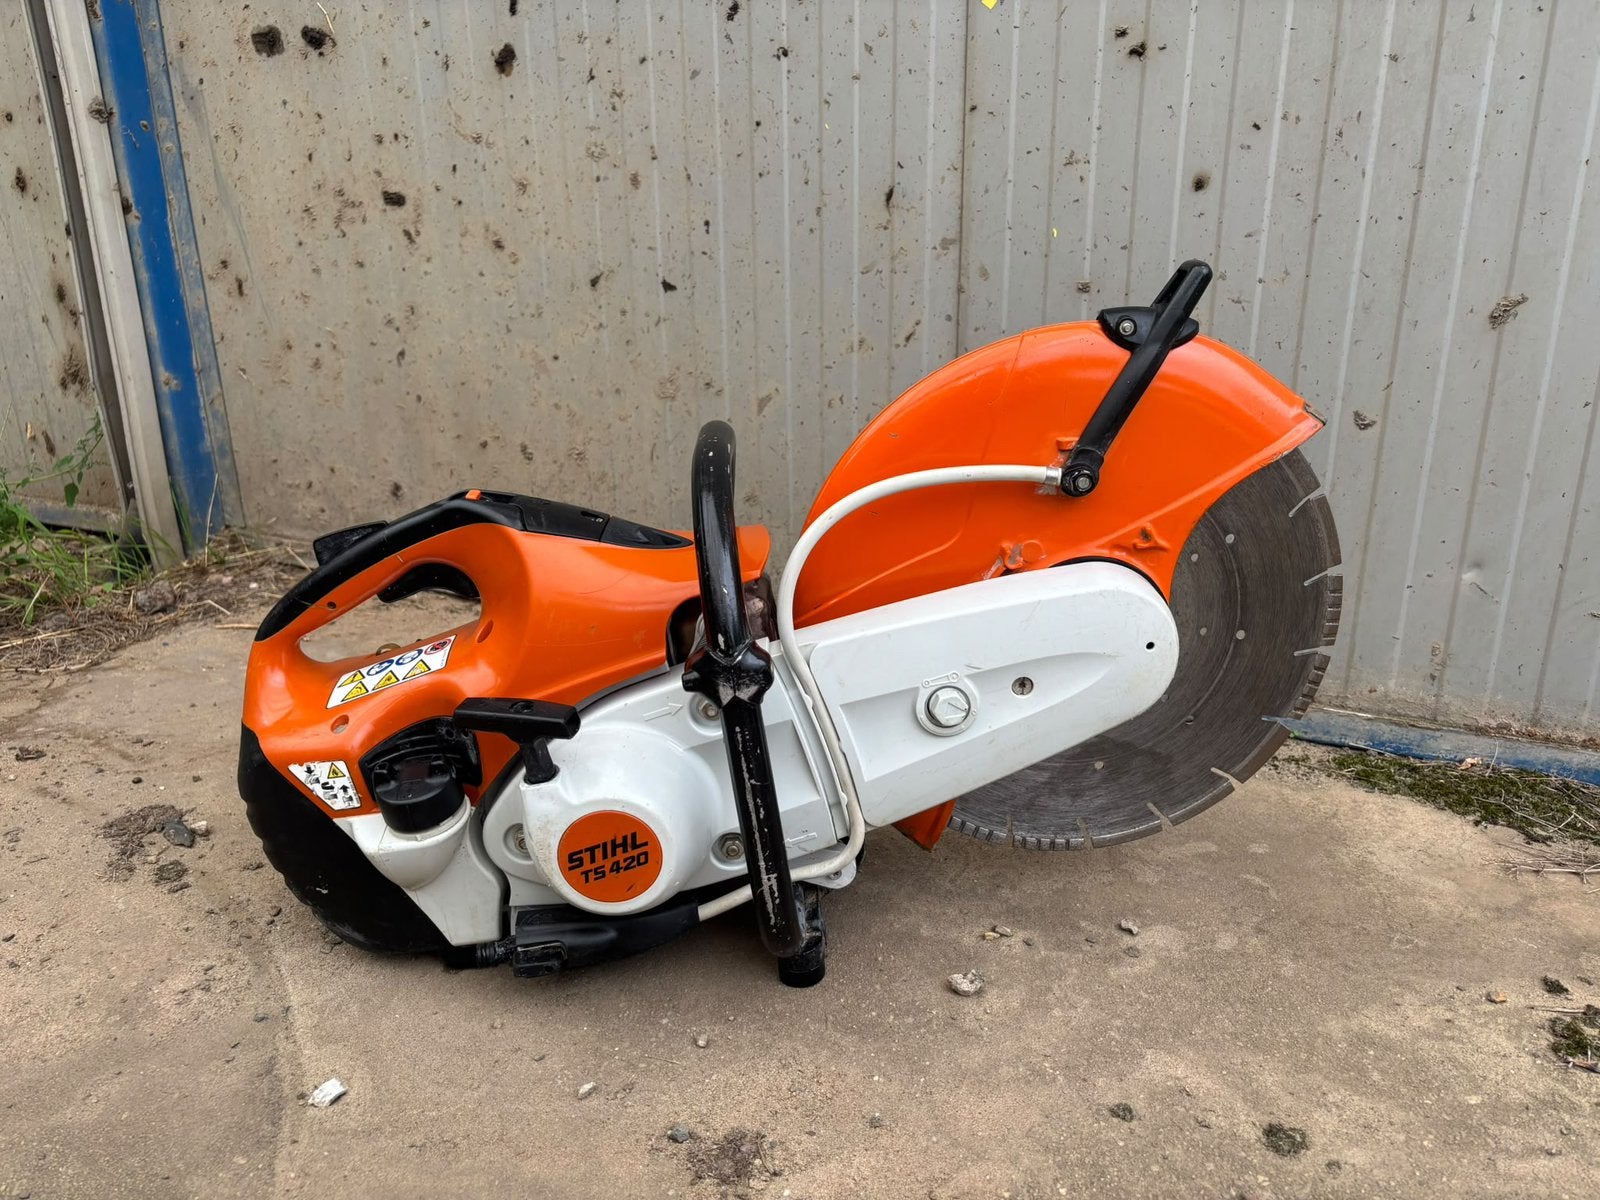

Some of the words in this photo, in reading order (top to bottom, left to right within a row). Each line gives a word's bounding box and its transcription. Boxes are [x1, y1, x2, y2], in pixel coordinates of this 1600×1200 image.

[567, 832, 649, 871] STIHL
[580, 865, 606, 884] TS
[609, 851, 649, 874] 420
